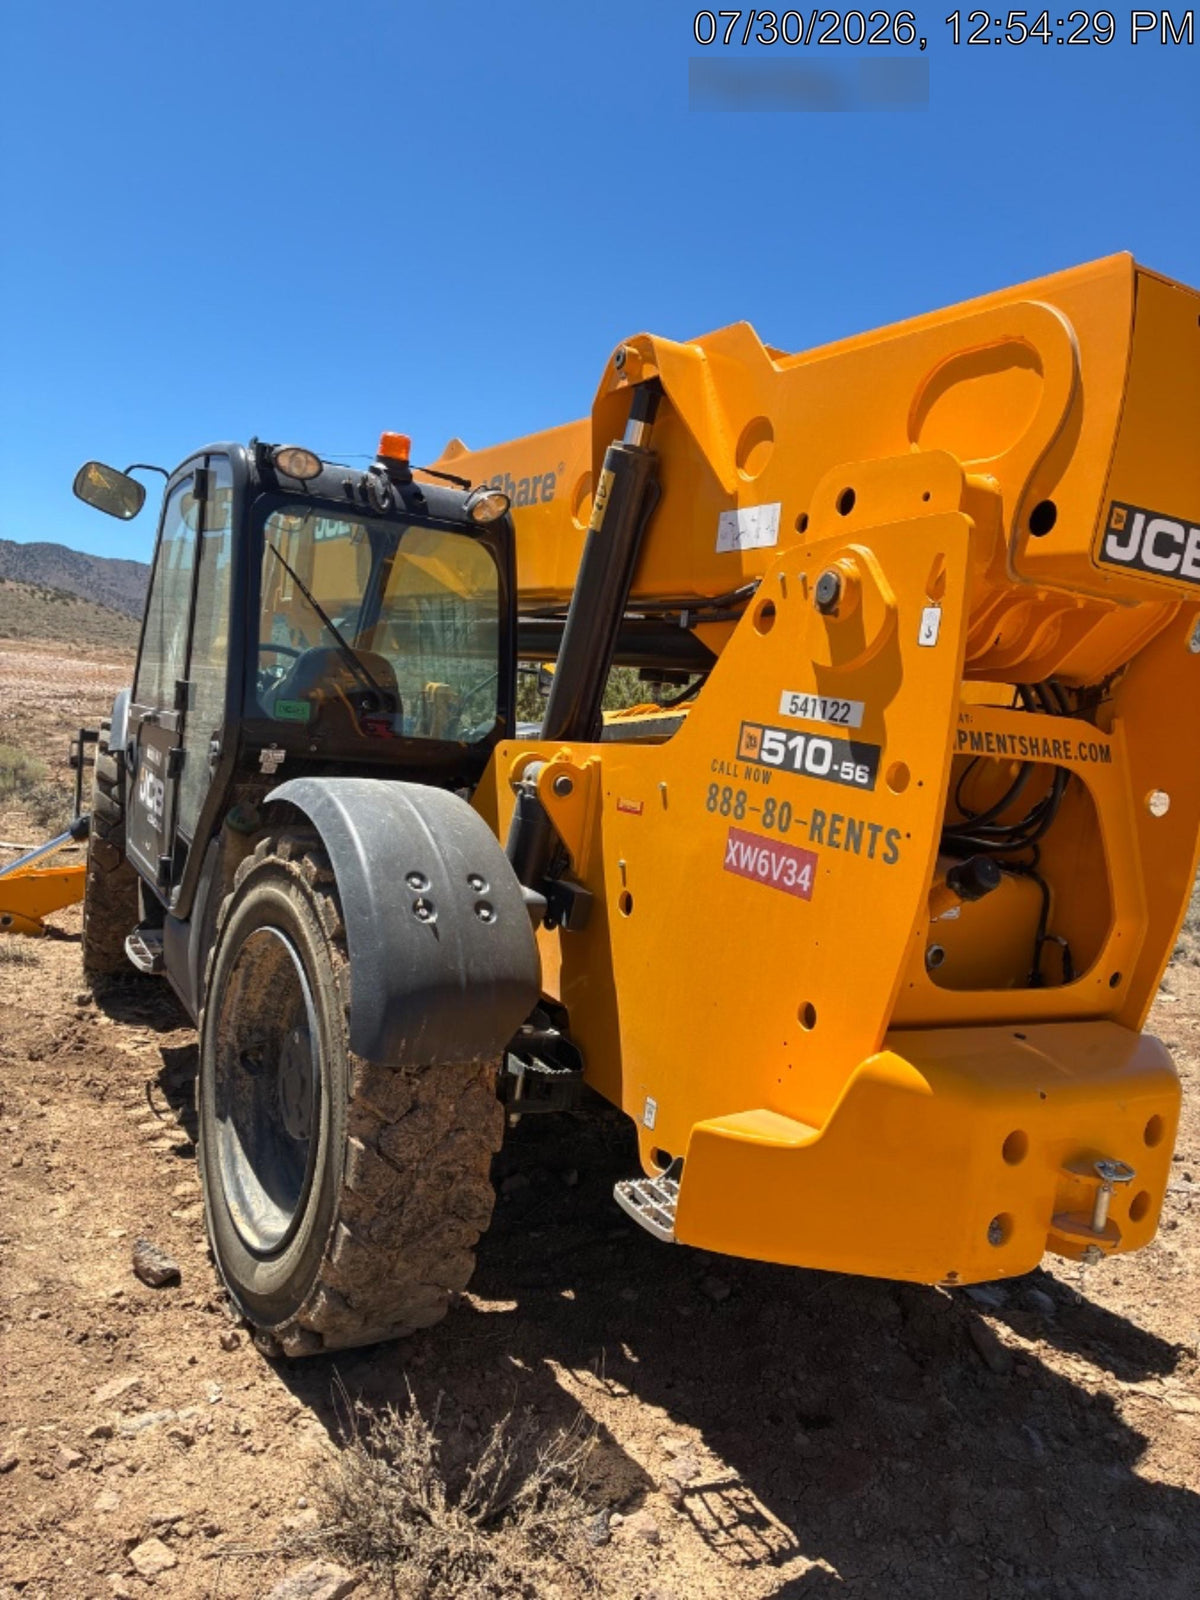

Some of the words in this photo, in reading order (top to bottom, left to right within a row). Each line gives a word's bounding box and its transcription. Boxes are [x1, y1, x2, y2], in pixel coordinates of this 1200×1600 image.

[789, 694, 851, 724] 541122
[139, 767, 165, 817] JCB
[710, 759, 739, 778] CALL
[744, 767, 773, 785] NOW
[706, 783, 902, 865] 888-80-RENTS
[725, 839, 812, 892] XW6V34
